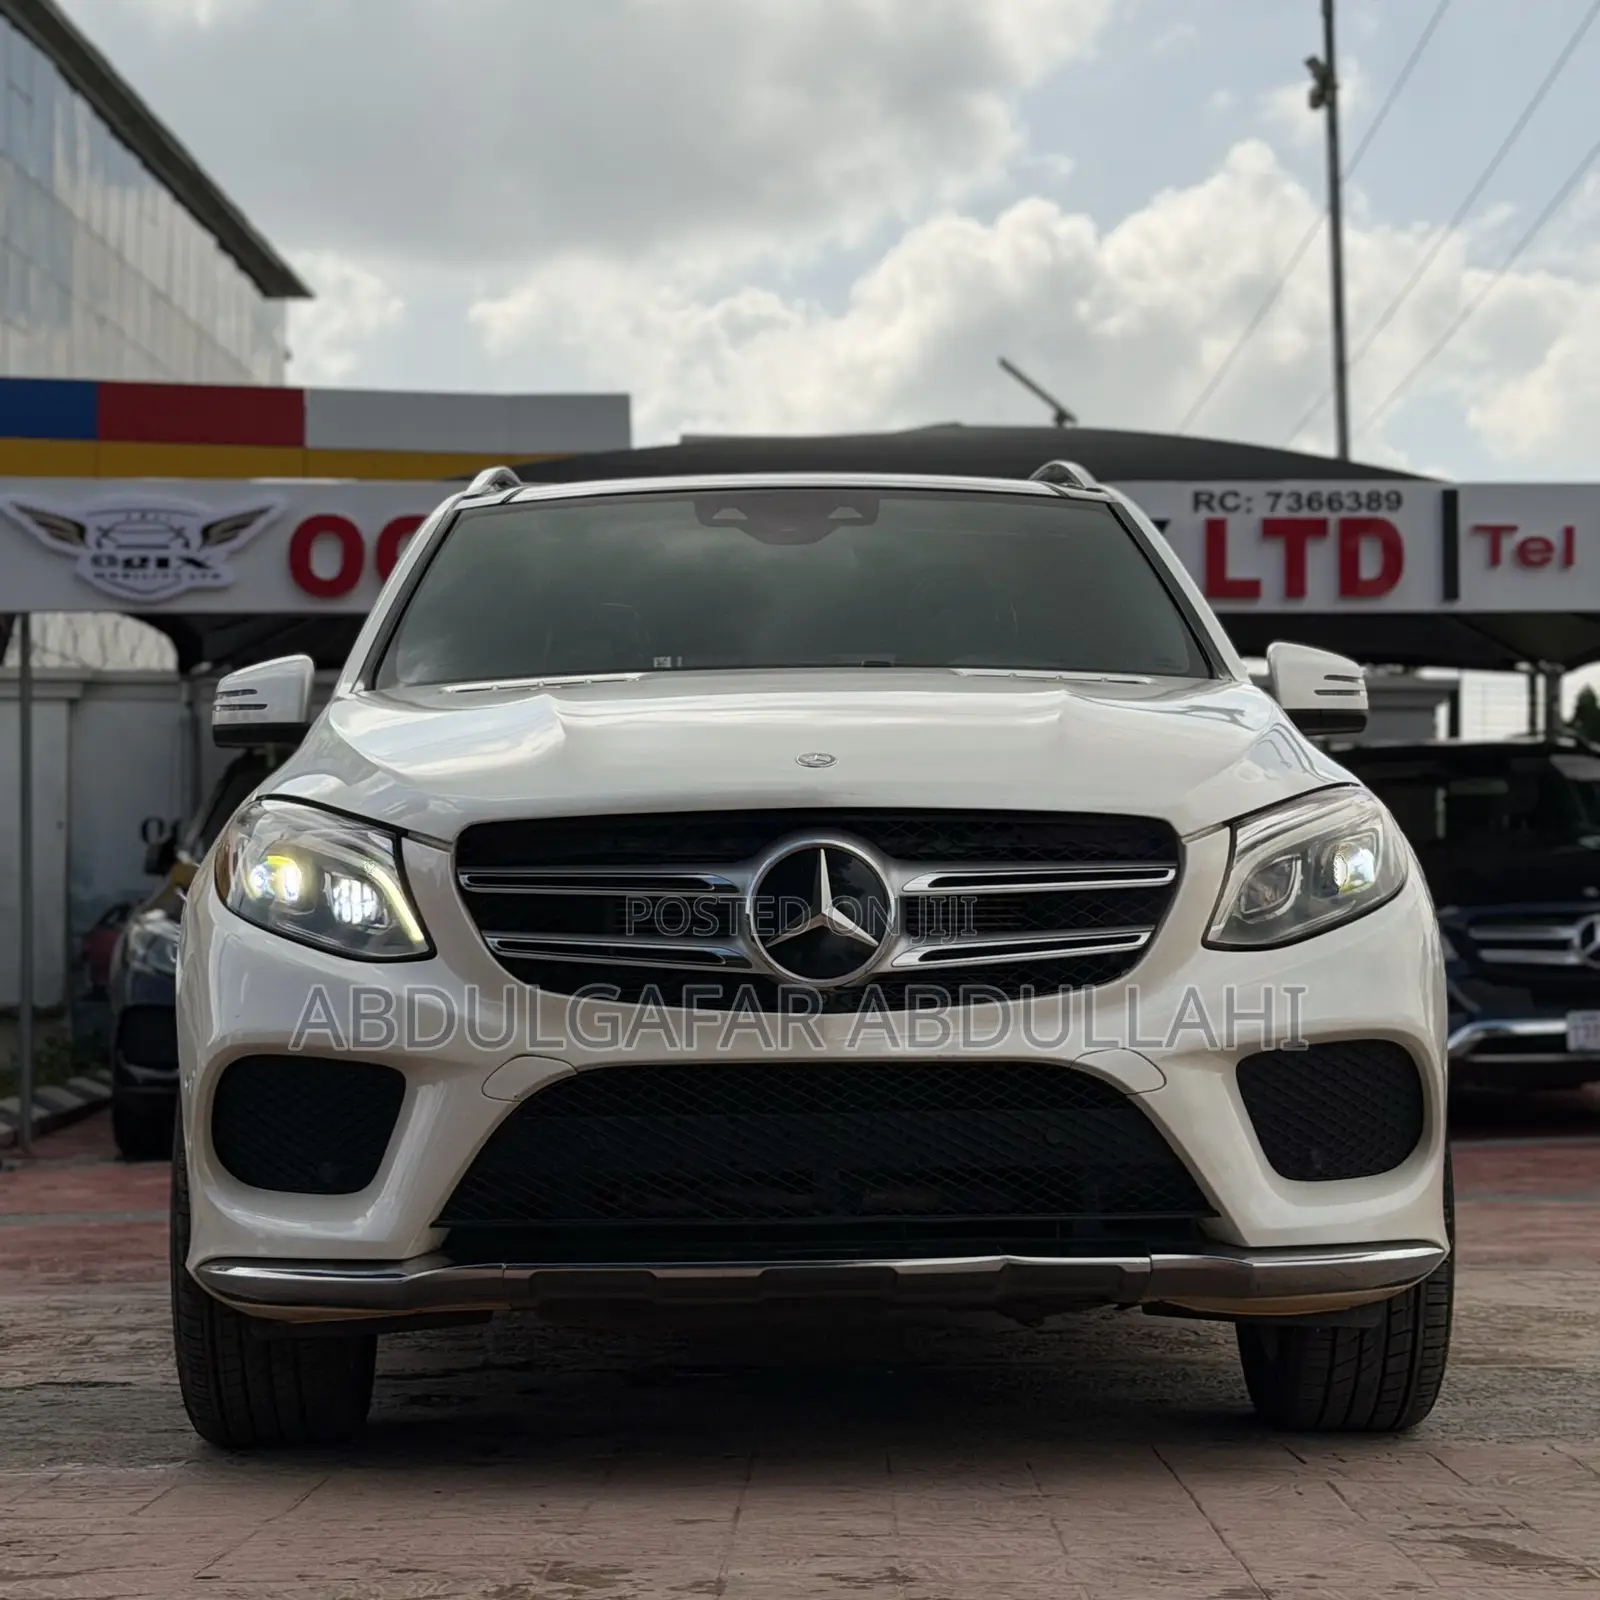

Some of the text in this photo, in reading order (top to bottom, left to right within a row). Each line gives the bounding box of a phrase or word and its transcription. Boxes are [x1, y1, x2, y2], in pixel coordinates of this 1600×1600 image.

[1193, 490, 1404, 513] RC: 7366389
[1204, 517, 1404, 599] LTD
[1471, 524, 1575, 568] Tel
